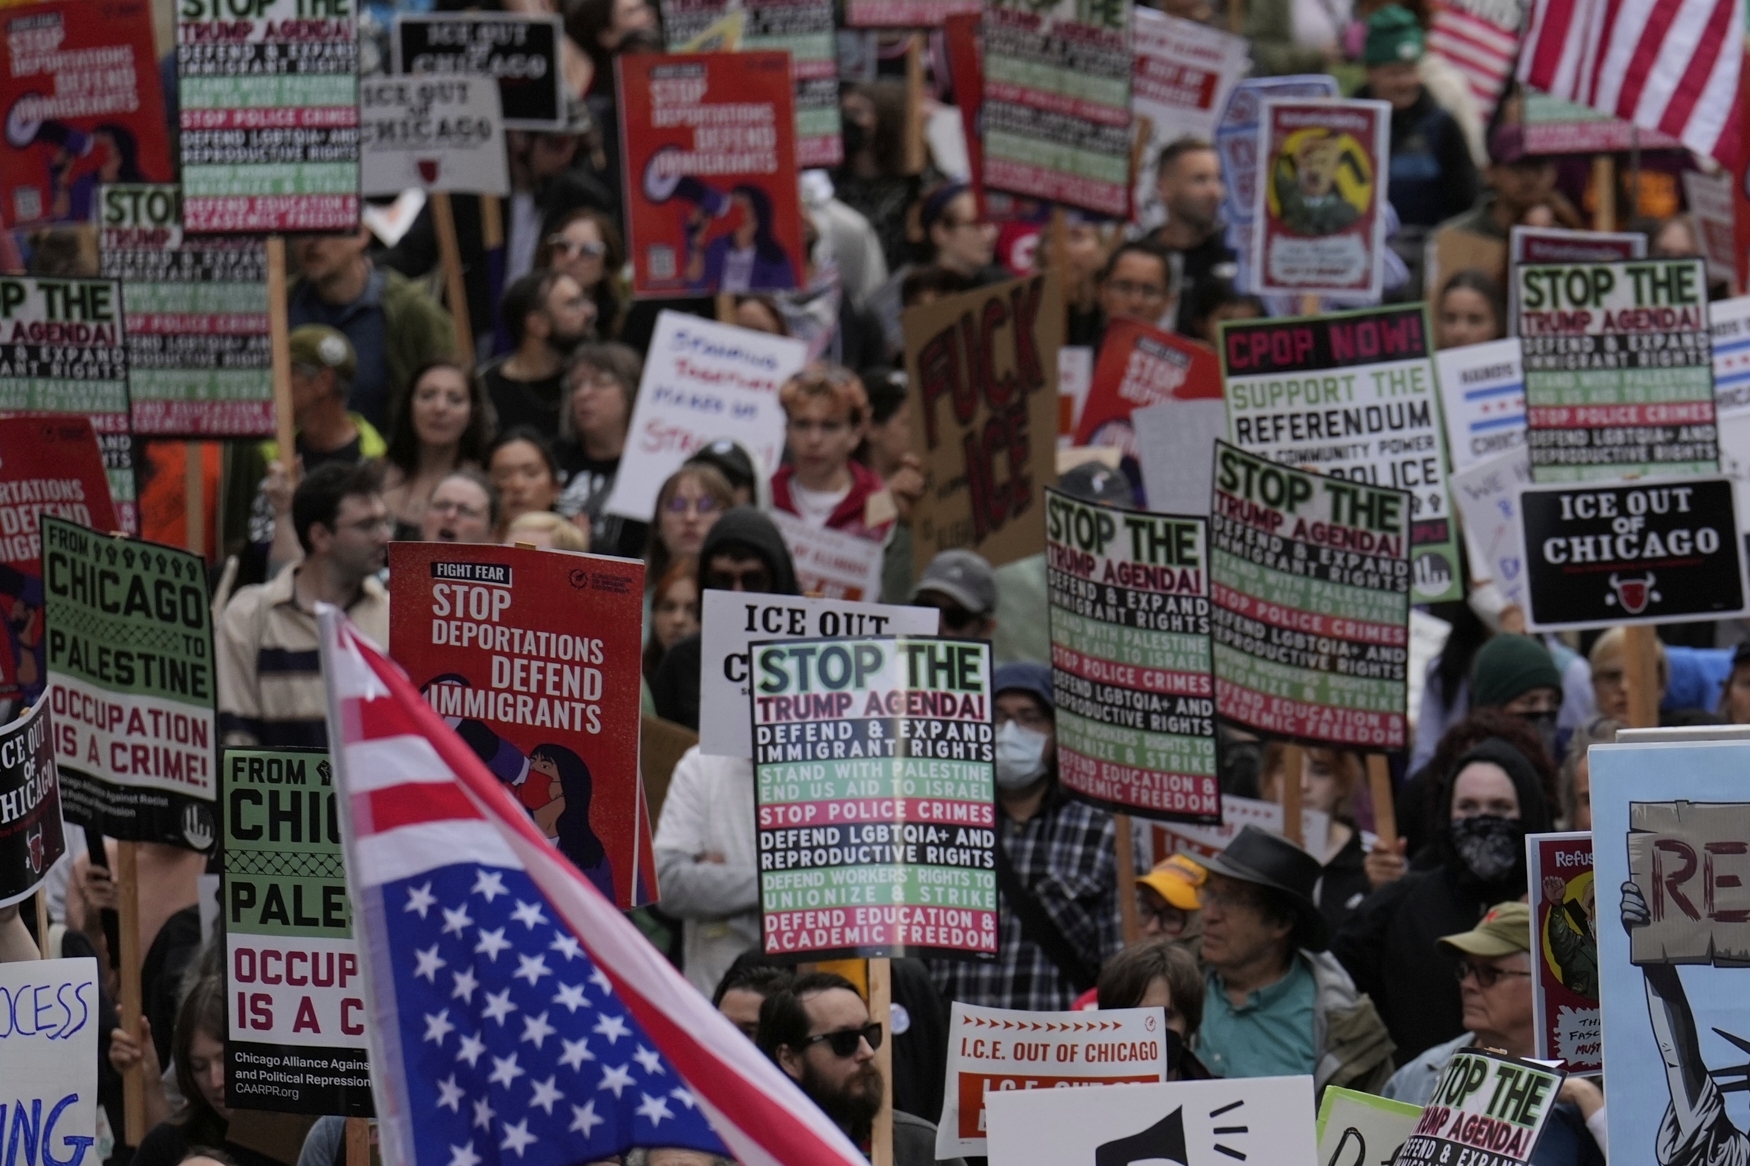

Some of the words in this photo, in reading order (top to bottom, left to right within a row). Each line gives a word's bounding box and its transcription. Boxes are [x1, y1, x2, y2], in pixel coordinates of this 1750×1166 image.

[1523, 266, 1615, 308] STOP
[1625, 264, 1698, 305] THE
[1561, 493, 1616, 520] ICE
[1627, 488, 1693, 515] OUT
[1612, 517, 1644, 535] OF
[50, 526, 89, 556] FROM
[1543, 528, 1719, 563] CHICAGO
[437, 563, 472, 578] FIGHT
[475, 565, 504, 581] FEAR
[50, 553, 204, 629] CHICAGO
[432, 583, 512, 622] STOP
[183, 634, 205, 658] TO
[432, 619, 604, 664] DEPORTATIONS
[51, 630, 208, 698] PALESTINE
[759, 645, 883, 692] STOP
[898, 645, 983, 692] THE
[492, 655, 602, 701] DEFEND
[52, 685, 208, 749] OCCUPATION
[430, 684, 601, 735] IMMIGRANTS
[756, 693, 853, 722] TRUMP
[863, 692, 984, 721] AGENDA!
[757, 722, 853, 744] DEFEND
[868, 720, 884, 738] &
[900, 721, 992, 743] EXPAND
[757, 739, 896, 763] IMMIGRANT
[911, 740, 993, 761] RIGHTS
[232, 757, 306, 785] FROM
[761, 764, 825, 783] STAND
[835, 763, 883, 779] WITH
[892, 762, 990, 782] PALESTINE
[760, 805, 817, 825] STOP
[829, 800, 906, 819] POLICE
[918, 801, 993, 823] CRIMES
[760, 827, 840, 849] DEFEND
[850, 825, 949, 845] LGBTQIA+
[956, 828, 995, 847] AND
[761, 846, 917, 870] REPRODUCTIVE
[926, 848, 994, 868] RIGHTS
[765, 910, 846, 932] DEFEND
[855, 908, 973, 928] EDUCATION
[981, 912, 994, 931] &
[765, 926, 884, 951] ACADEMIC
[897, 926, 995, 949] FREEDOM
[238, 992, 273, 1031] IS
[292, 996, 321, 1034] A
[235, 1052, 280, 1067] Chicago
[283, 1055, 328, 1069] Alliance
[961, 1037, 1006, 1060] I.C.E.
[1013, 1042, 1050, 1061] OUT
[1057, 1044, 1078, 1062] OF
[1085, 1041, 1158, 1062] CHICAGO
[236, 1069, 256, 1080] and
[259, 1070, 304, 1083] Political
[306, 1074, 371, 1087] Repression
[235, 1083, 299, 1100] CAARPR.org
